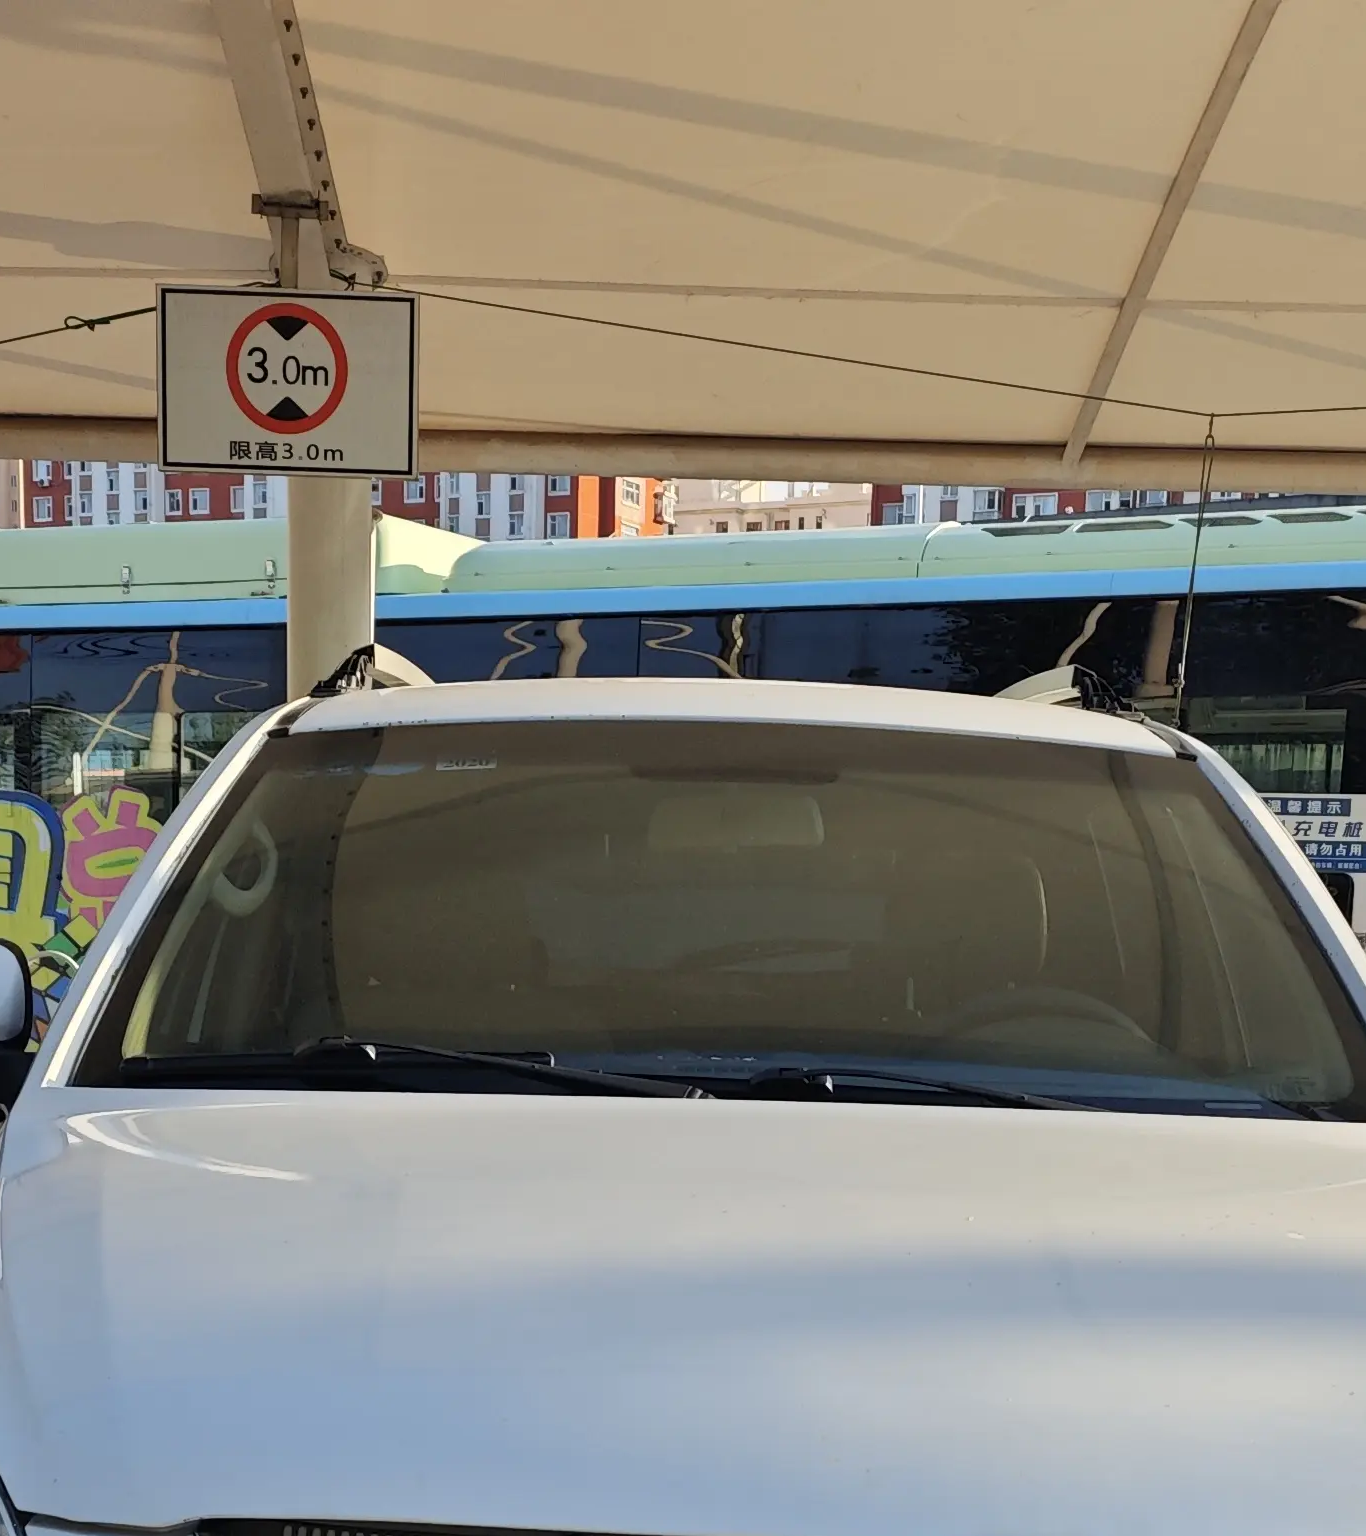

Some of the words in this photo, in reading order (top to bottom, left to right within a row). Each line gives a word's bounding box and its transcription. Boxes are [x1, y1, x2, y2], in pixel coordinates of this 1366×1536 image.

[246, 346, 329, 387] 3.0m
[229, 440, 344, 462] 限高3.0m
[1280, 820, 1364, 838] 充电桩
[1305, 843, 1362, 857] 请勿占用
